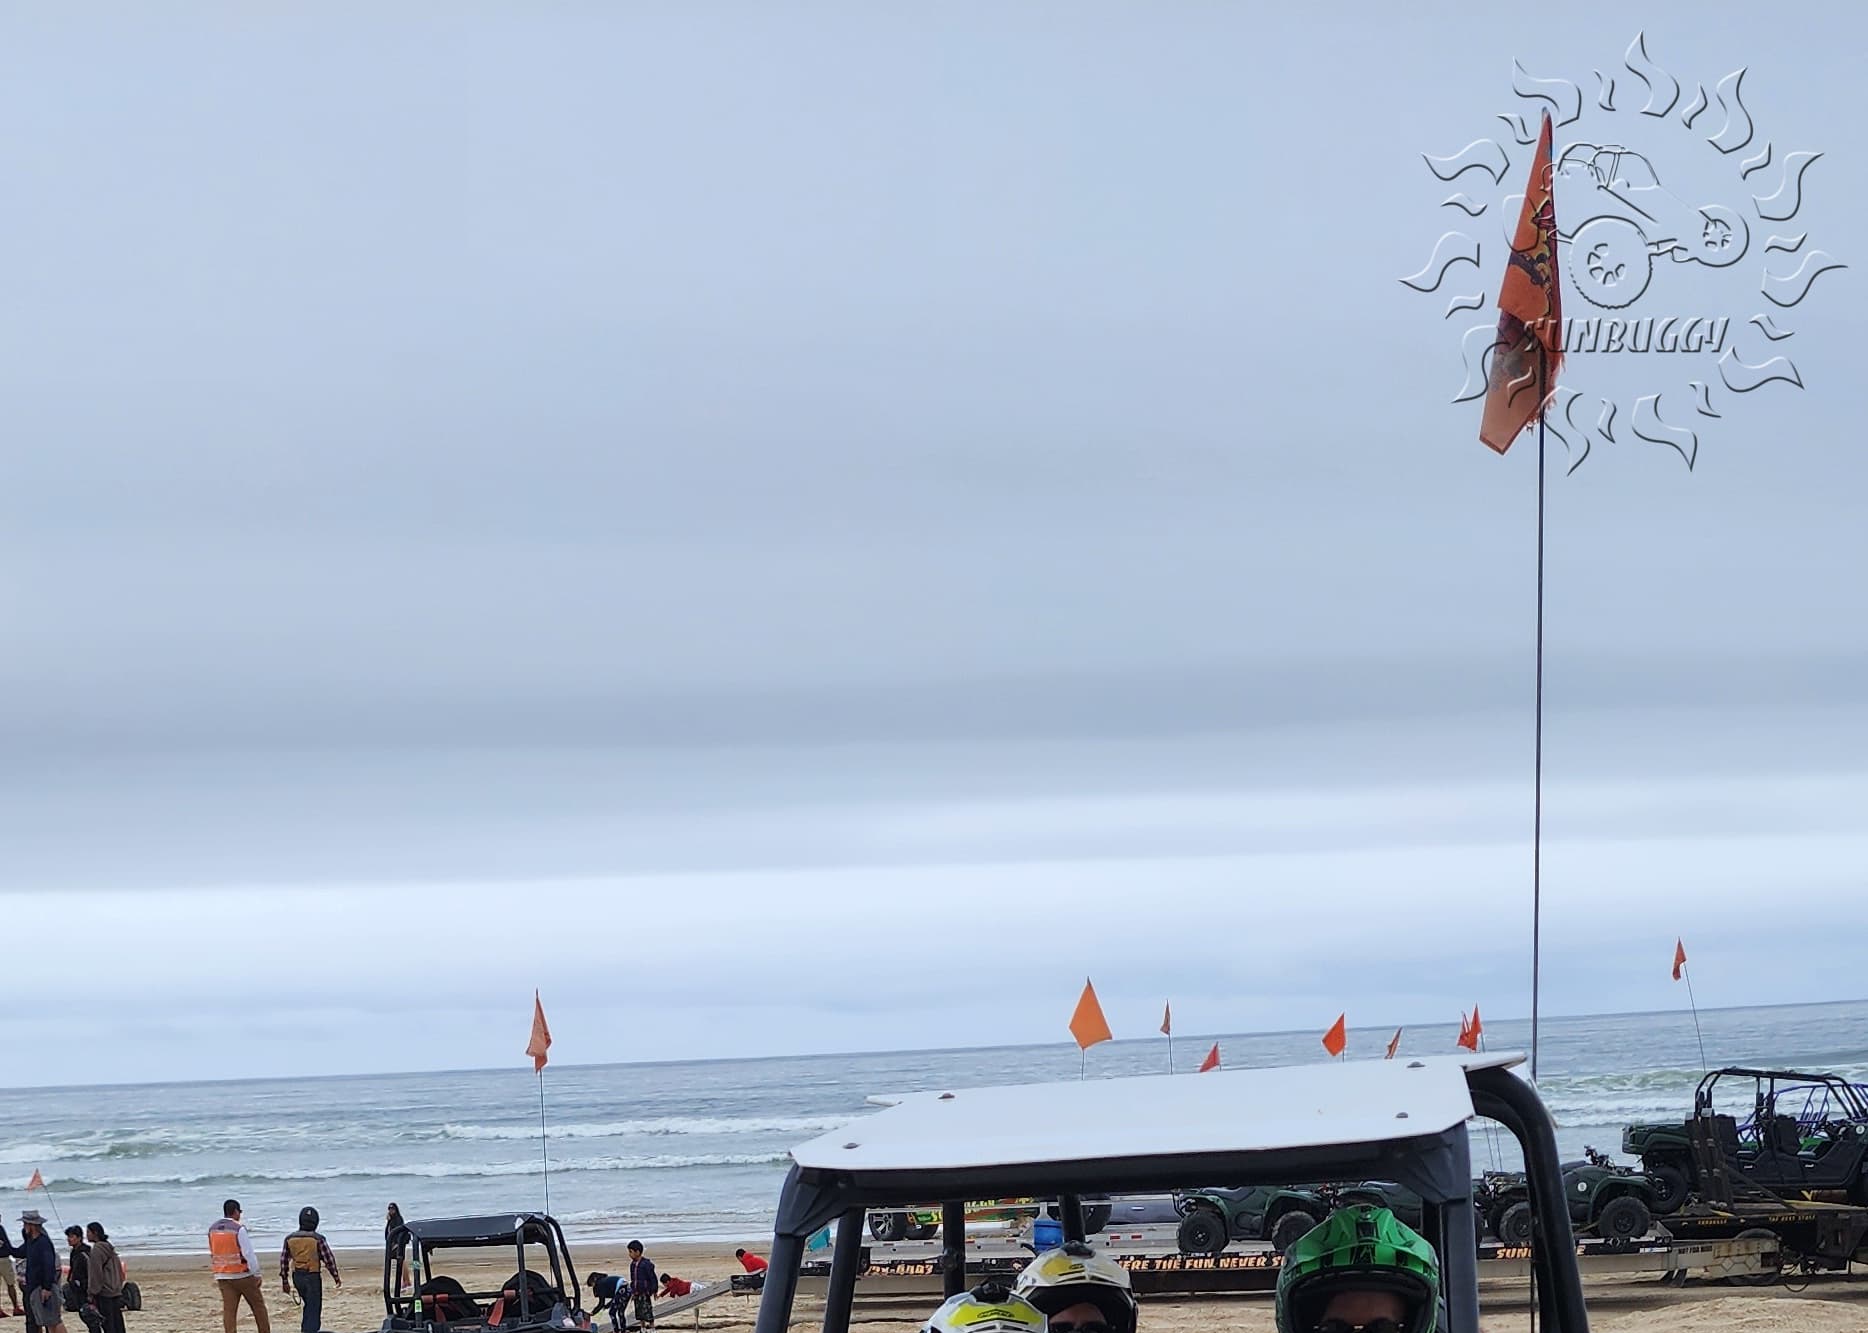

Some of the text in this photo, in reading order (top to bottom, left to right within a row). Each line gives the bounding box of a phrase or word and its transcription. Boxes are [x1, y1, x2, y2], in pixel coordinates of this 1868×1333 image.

[1154, 1258, 1182, 1270] THE
[1185, 1257, 1216, 1270] FUN
[1219, 1255, 1267, 1269] NEVER
